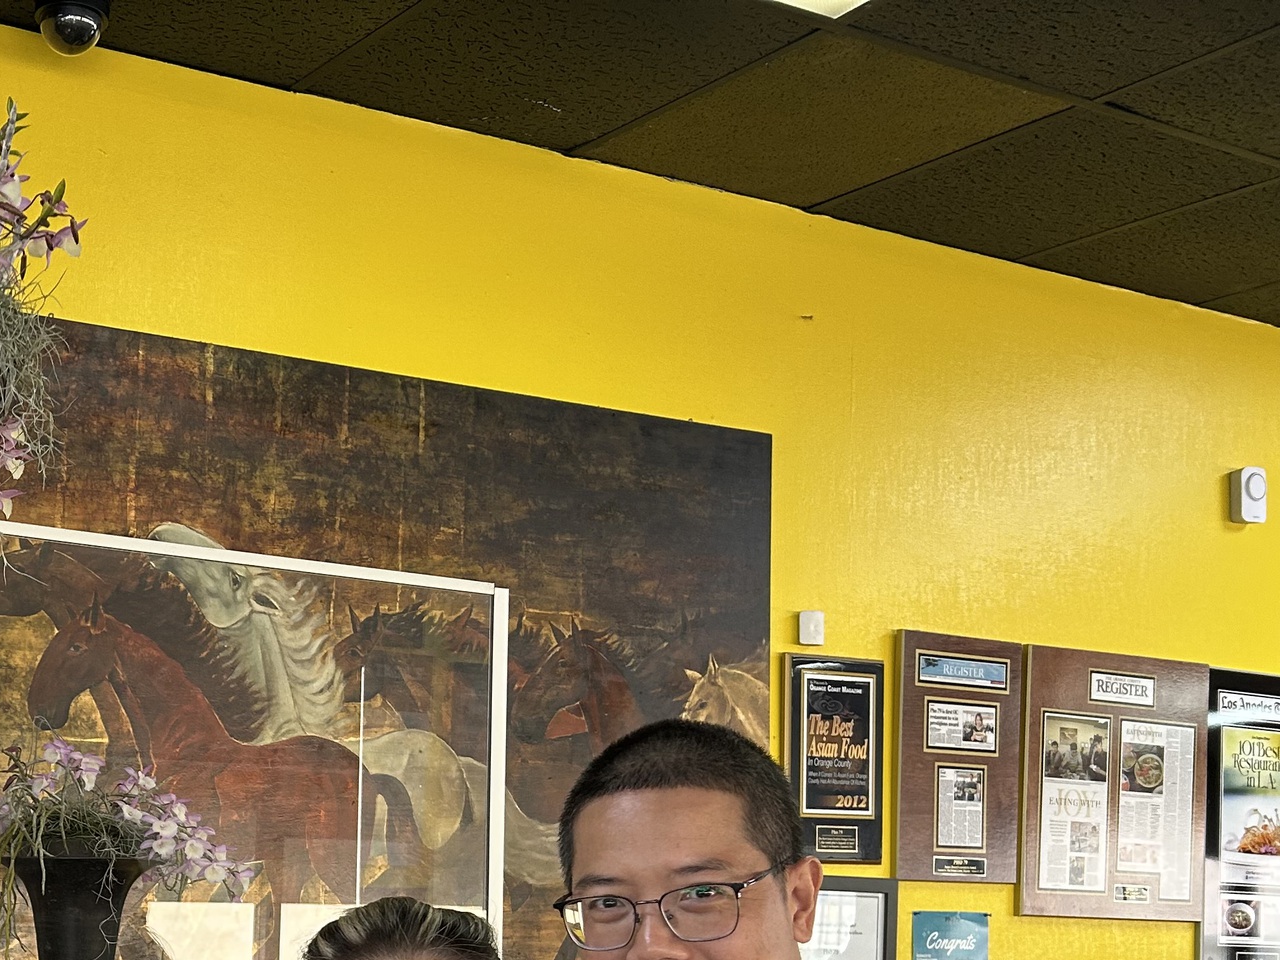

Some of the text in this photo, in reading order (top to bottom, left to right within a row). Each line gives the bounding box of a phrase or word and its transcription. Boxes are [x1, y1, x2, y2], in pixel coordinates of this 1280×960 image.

[943, 664, 985, 678] REGISTER
[1095, 679, 1148, 698] REGISTER
[1221, 696, 1273, 712] Los Angeles
[809, 714, 855, 737] The Best
[808, 736, 868, 760] Asian Food
[1239, 740, 1255, 757] 101
[808, 758, 852, 769] In Orange County
[835, 795, 867, 808] 2012
[1049, 797, 1101, 808] EATING WITH
[1054, 788, 1097, 817] JOY
[926, 931, 977, 956] Congrats
